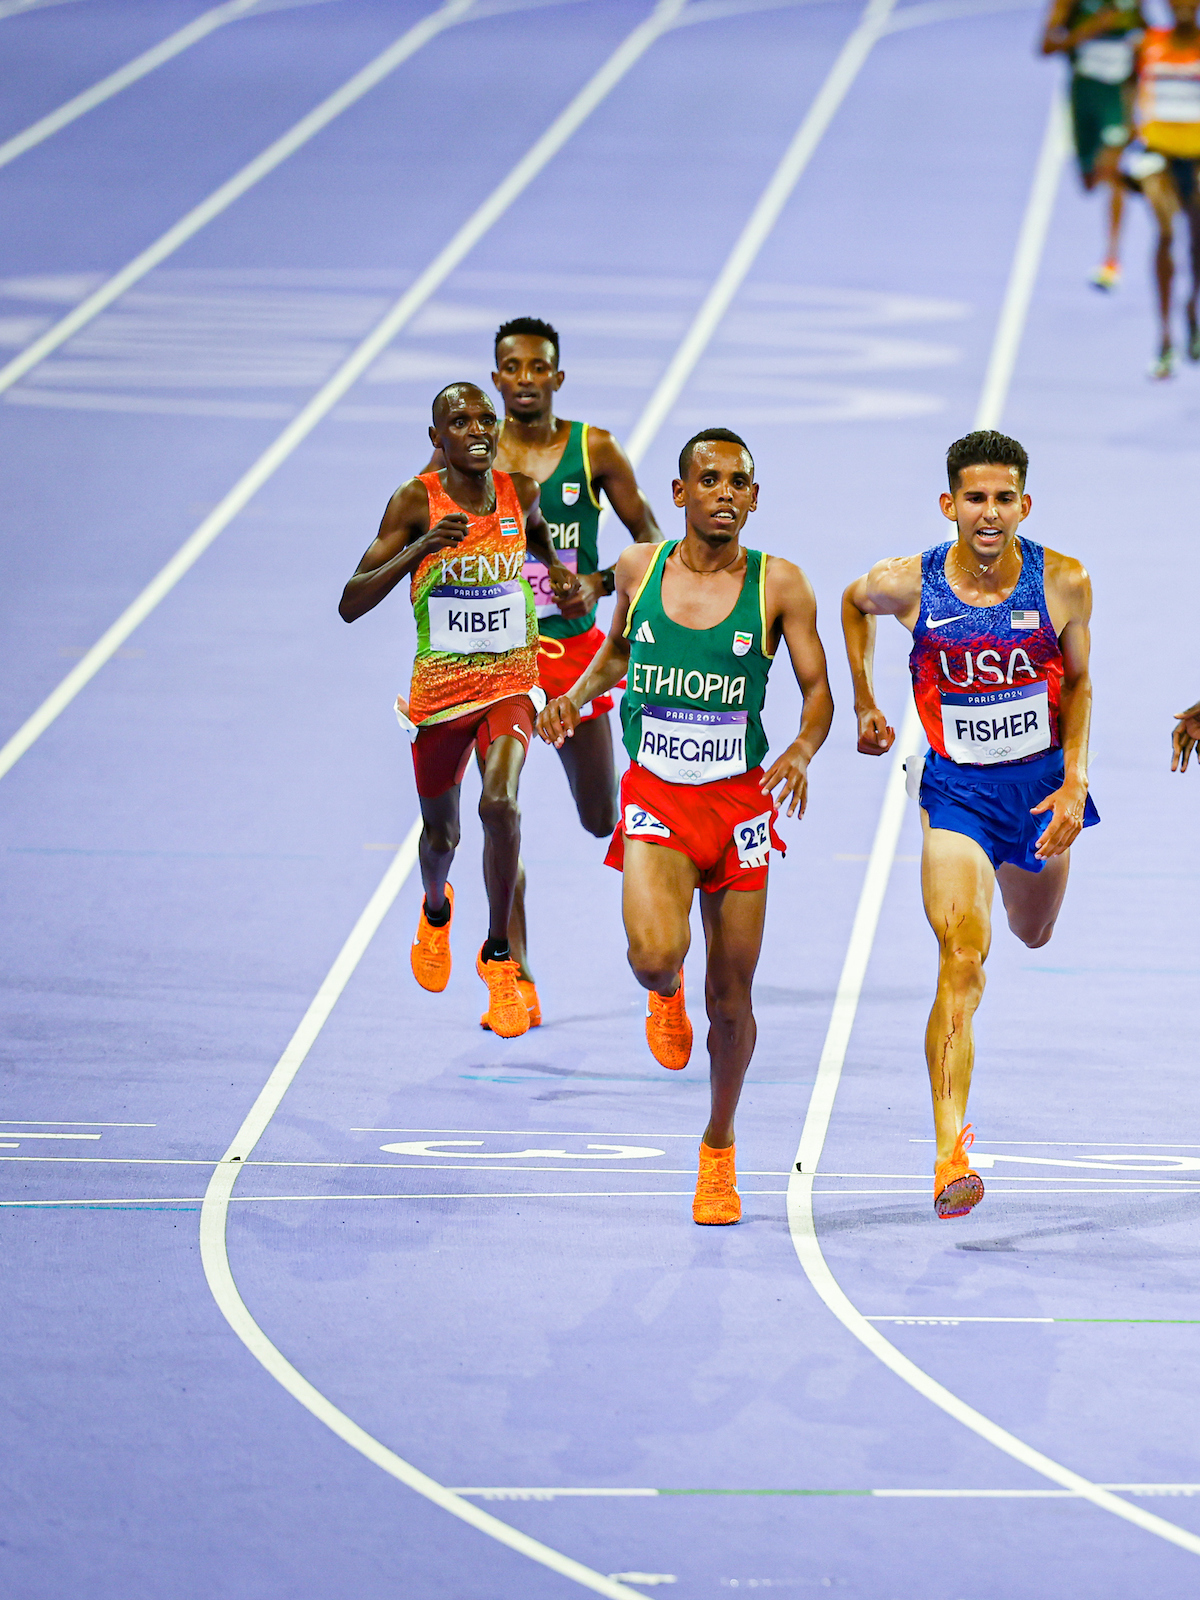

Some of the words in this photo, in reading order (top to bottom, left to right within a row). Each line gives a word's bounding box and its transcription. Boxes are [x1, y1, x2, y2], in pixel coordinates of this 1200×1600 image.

[454, 588, 480, 597] PARIS
[448, 607, 511, 633] KIBET
[939, 647, 1038, 688] USA
[632, 662, 746, 705] ETHIOPIA
[968, 696, 996, 704] PARIS
[998, 690, 1023, 700] 2024
[666, 711, 694, 721] PARIS
[696, 714, 722, 722] 2024
[955, 710, 1038, 742] FISHER
[641, 731, 742, 762] AREGAWI
